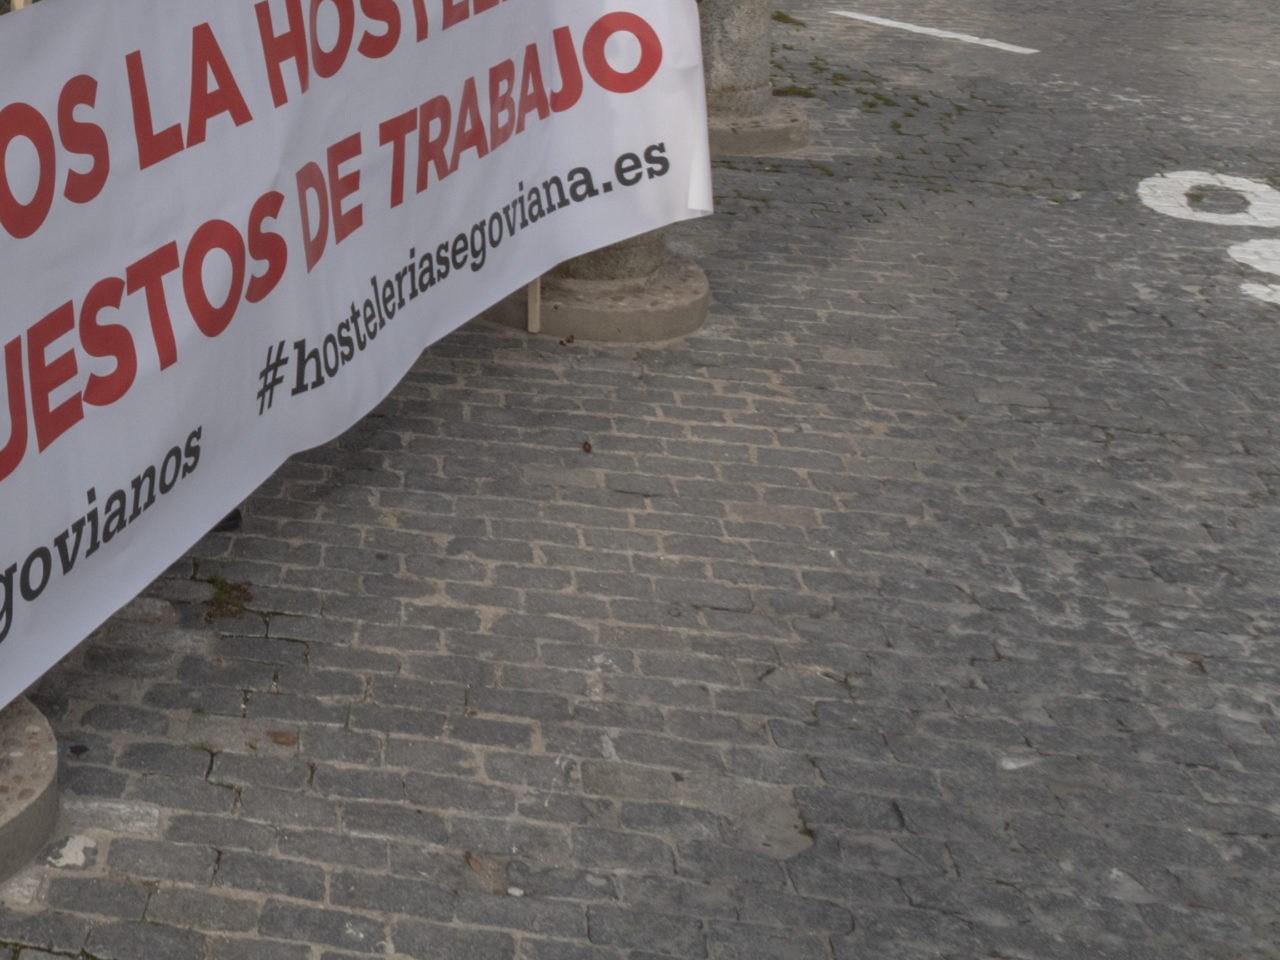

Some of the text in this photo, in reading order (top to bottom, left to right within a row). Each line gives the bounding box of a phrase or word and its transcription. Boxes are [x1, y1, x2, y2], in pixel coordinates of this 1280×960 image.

[126, 35, 254, 171] LA
[296, 132, 364, 275] DE
[378, 10, 663, 209] TRABAJO
[257, 142, 670, 416] #hosteleriasegoviana.es
